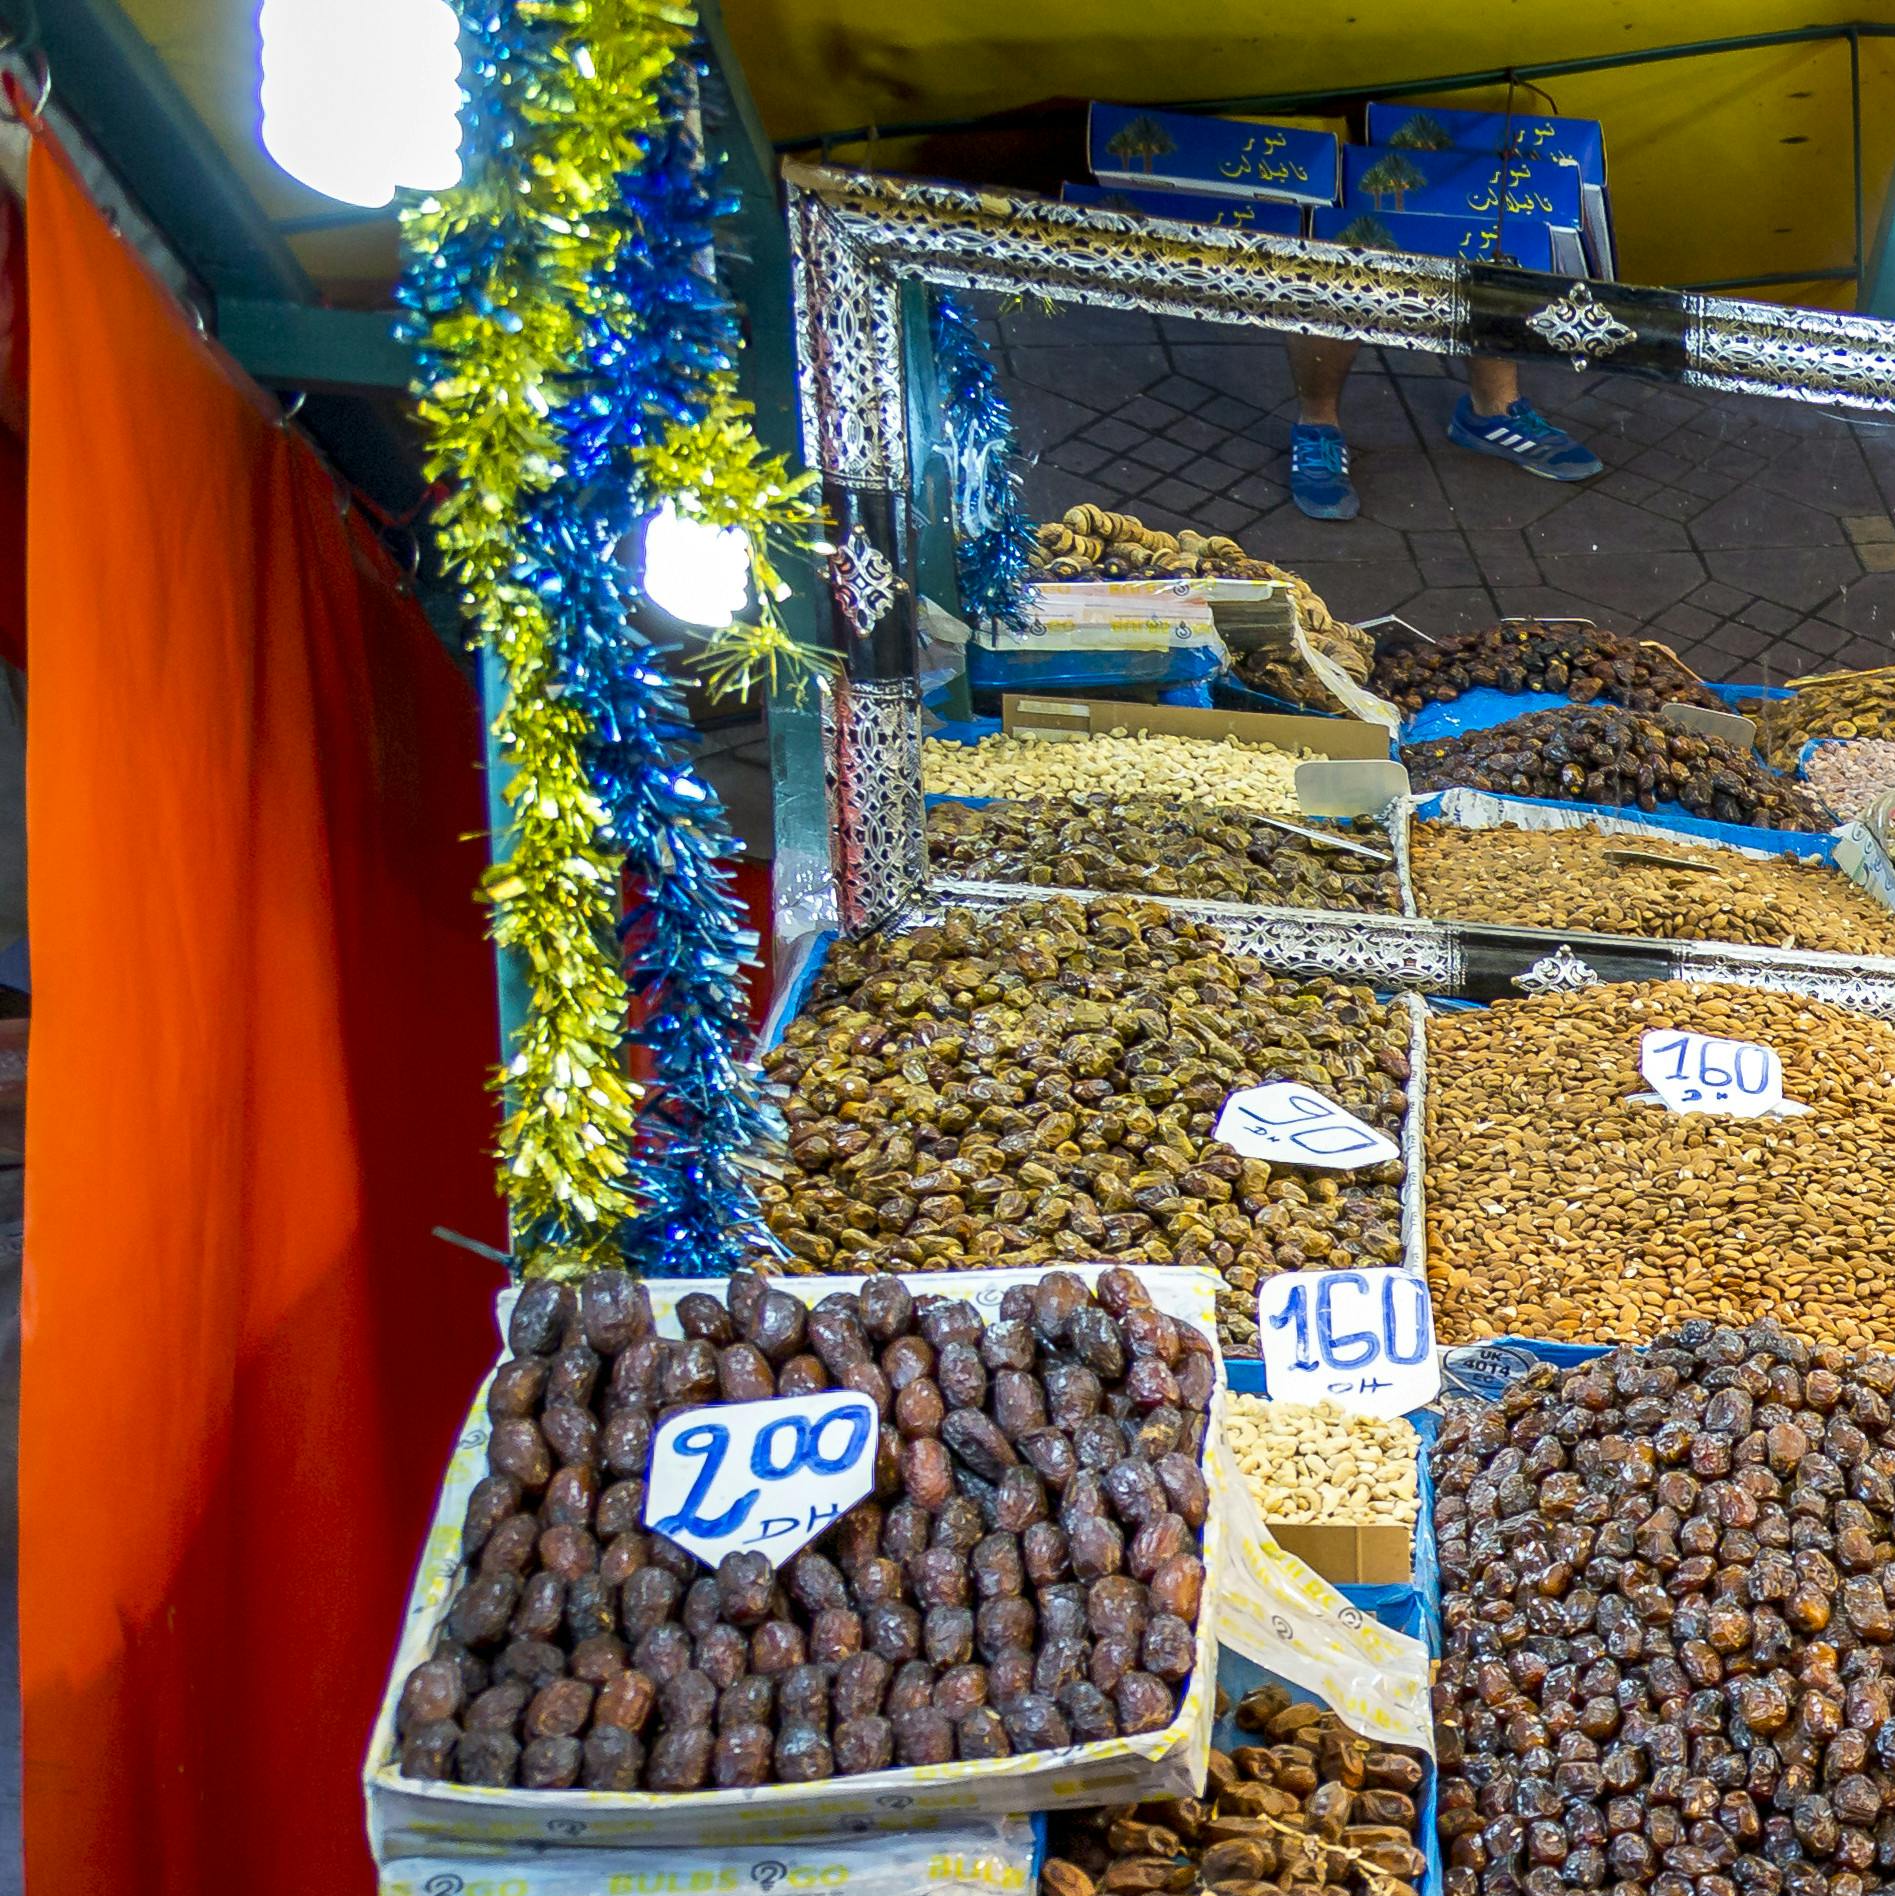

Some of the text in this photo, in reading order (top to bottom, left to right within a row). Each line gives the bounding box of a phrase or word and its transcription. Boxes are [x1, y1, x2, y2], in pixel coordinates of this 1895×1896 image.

[1242, 131, 1288, 154] نور
[1653, 1036, 1769, 1095] 160
[1238, 1096, 1378, 1154] 90
[1268, 1272, 1429, 1373] 160
[1463, 1359, 1511, 1378] 4014
[741, 1503, 840, 1544] DH
[608, 1868, 738, 1896] BULBS
[788, 1863, 850, 1889] GO
